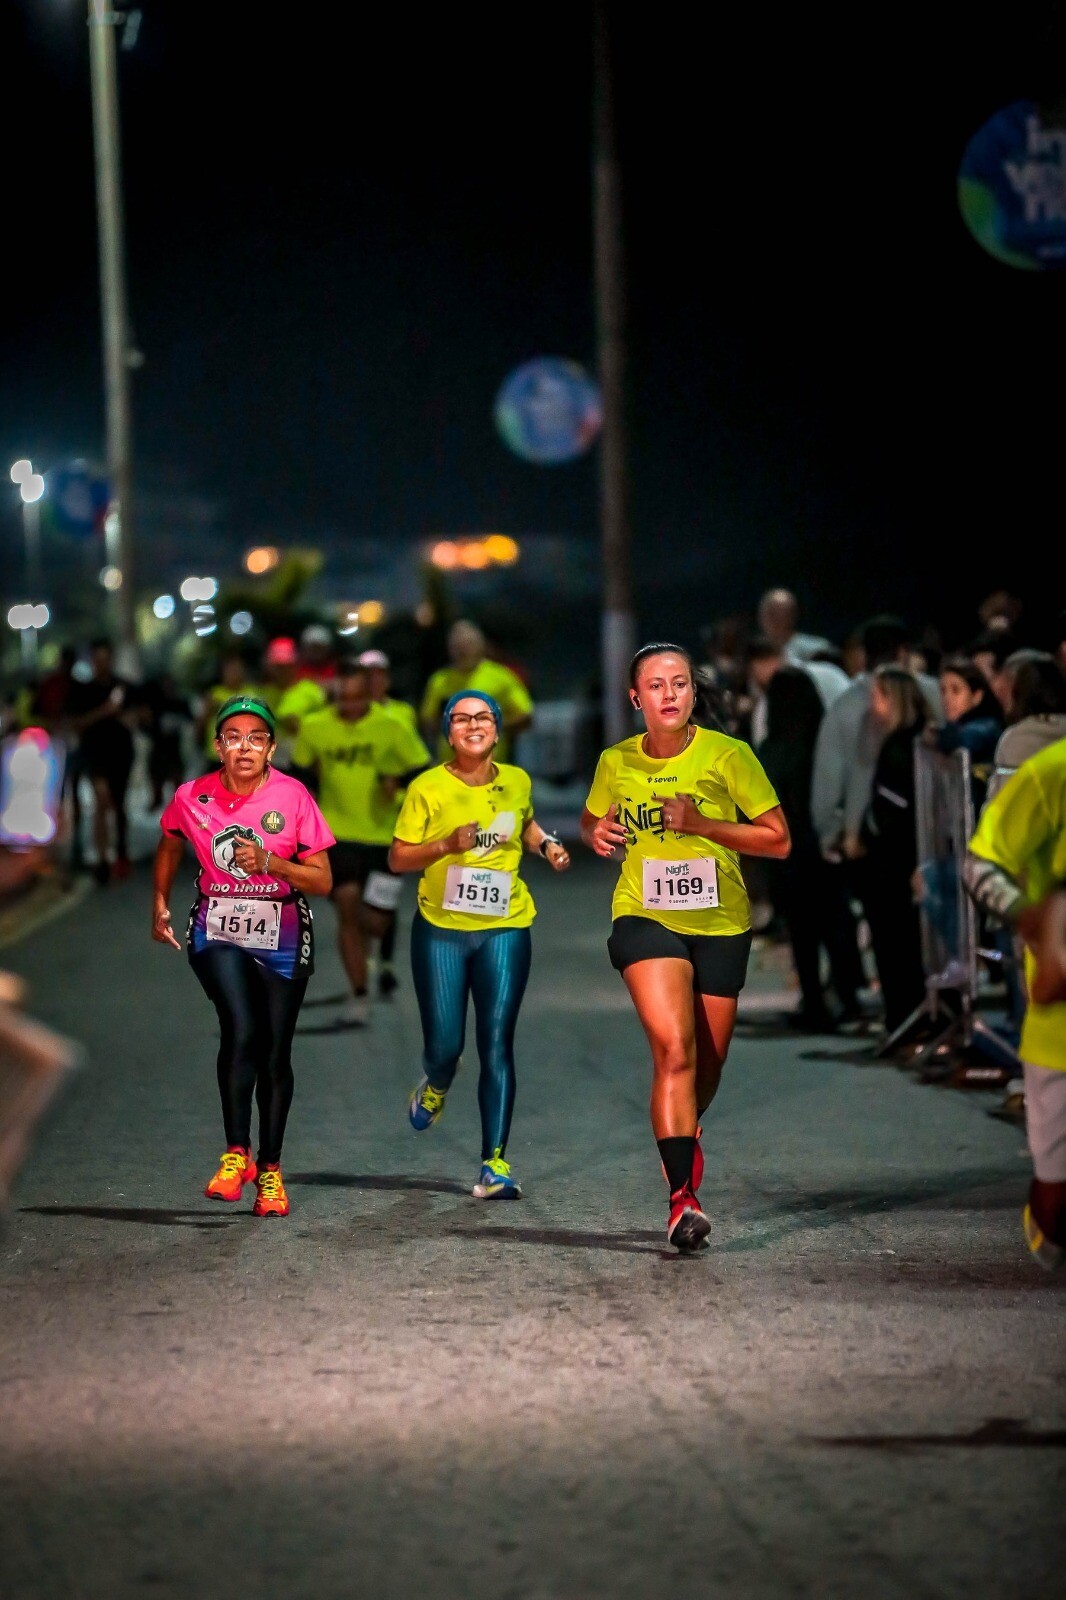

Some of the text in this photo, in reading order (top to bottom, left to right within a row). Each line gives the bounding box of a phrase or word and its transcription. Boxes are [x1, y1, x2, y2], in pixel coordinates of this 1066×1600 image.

[624, 802, 667, 835] Nig
[471, 873, 492, 884] Night
[665, 862, 690, 876] Night
[209, 882, 279, 893] 100 LIMITES
[456, 883, 500, 903] 1513
[653, 877, 703, 896] 1169
[218, 915, 267, 935] 1514
